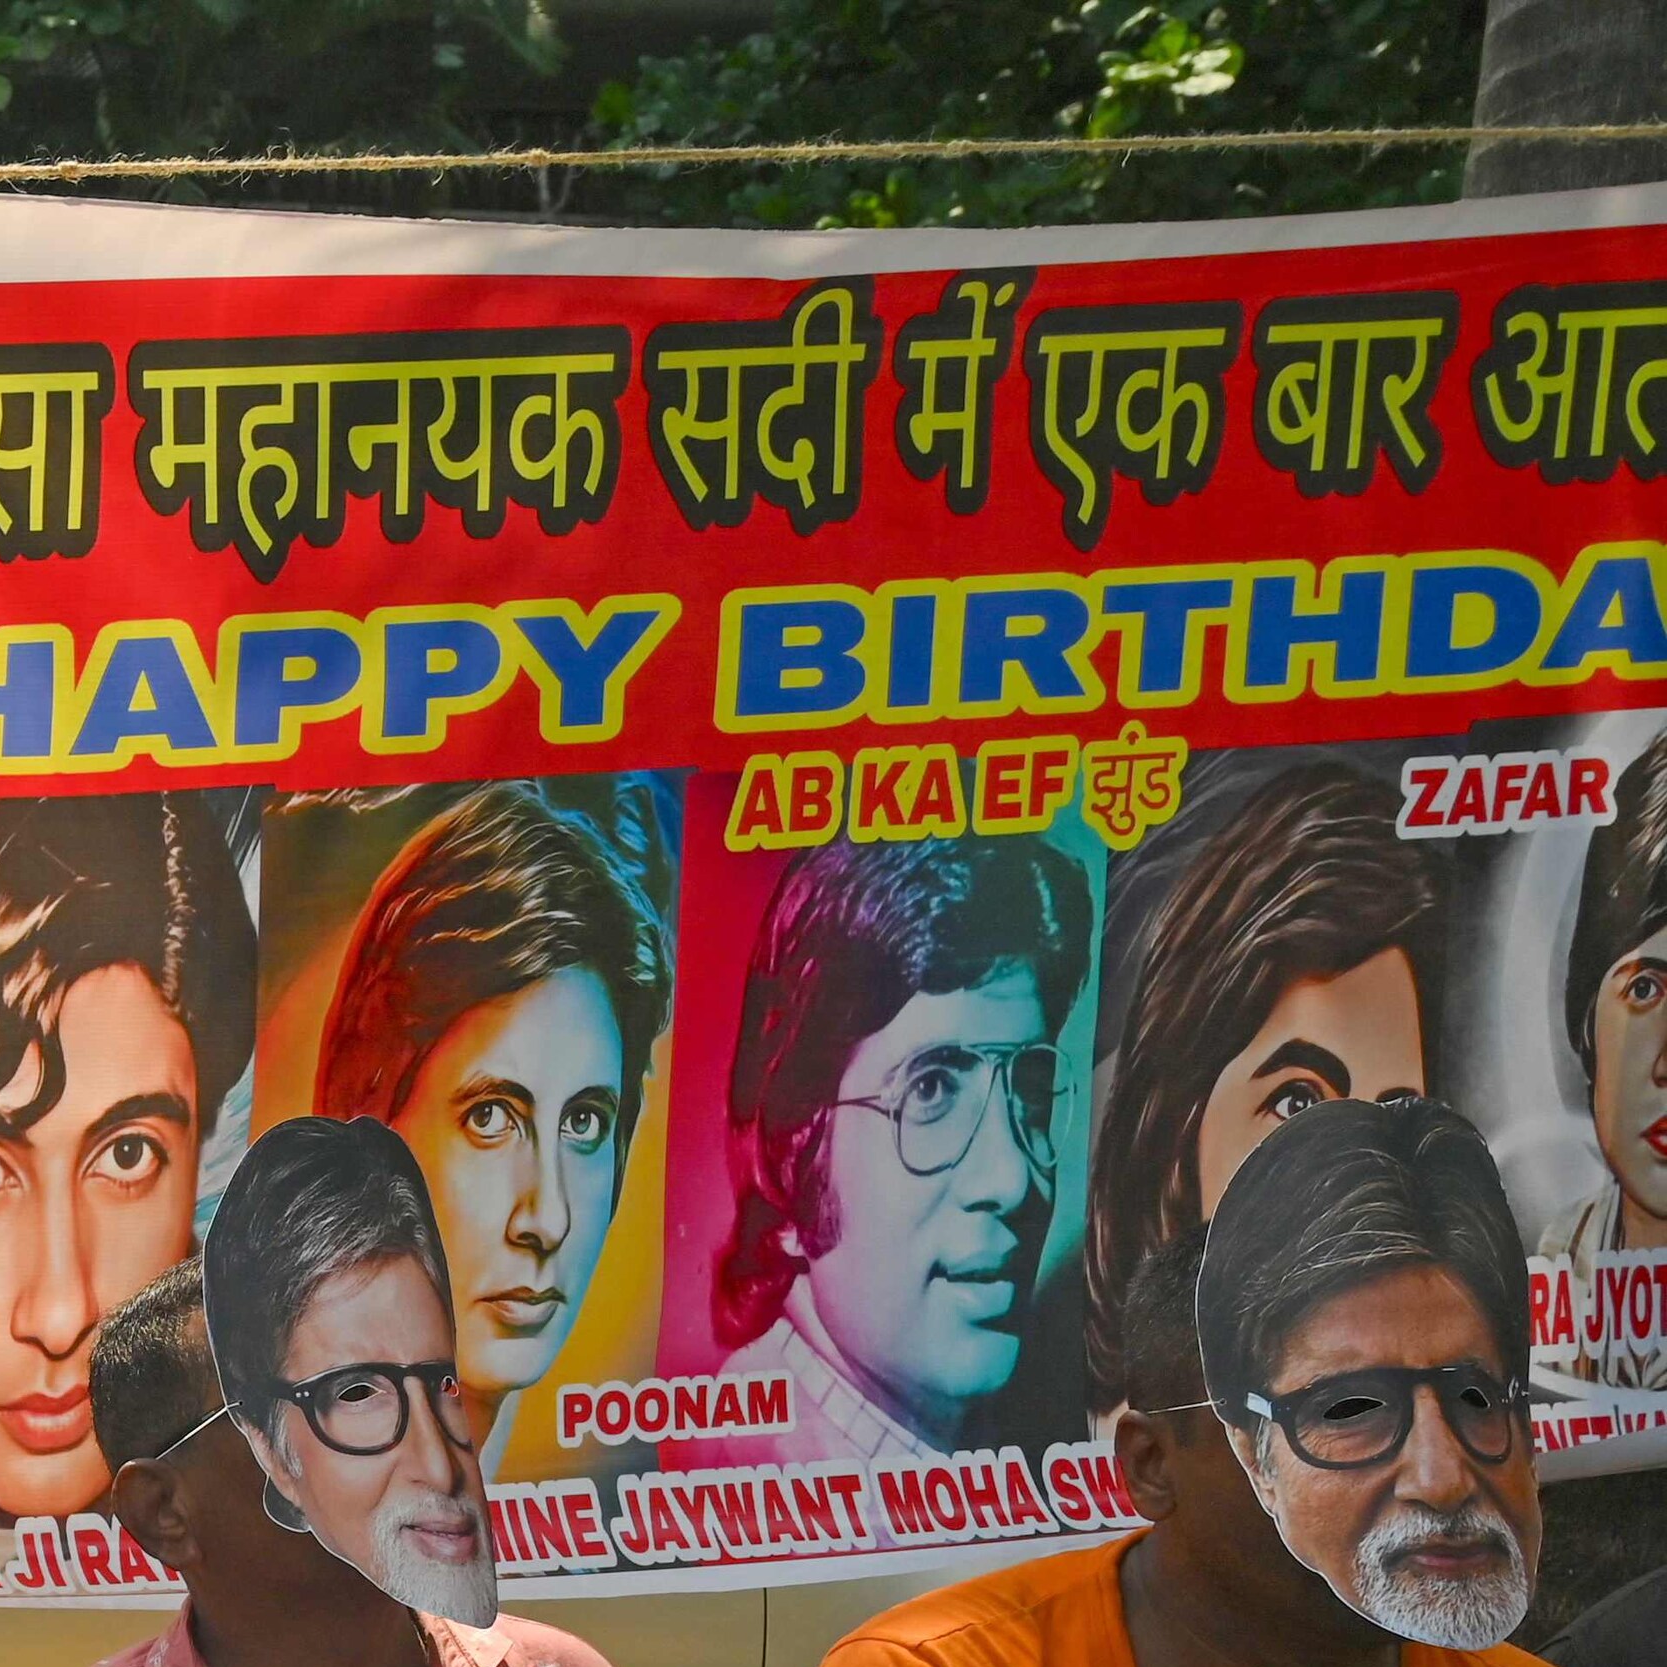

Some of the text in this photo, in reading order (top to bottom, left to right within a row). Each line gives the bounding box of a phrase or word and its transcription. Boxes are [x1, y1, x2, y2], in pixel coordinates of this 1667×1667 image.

[142, 352, 615, 557] महानयक
[658, 288, 866, 509] सदी
[909, 281, 1015, 489] में
[1038, 327, 1226, 525] एक
[1266, 317, 1442, 472] बार
[735, 766, 833, 836] AB
[858, 758, 956, 828] KA
[982, 750, 1070, 820] EF
[1408, 758, 1609, 828] ZAFAR
[1529, 1269, 1576, 1346] RA
[563, 1379, 789, 1439] POONAM
[620, 1475, 867, 1553] JAYWANT
[877, 1461, 1049, 1534] MOHA
[15, 1532, 68, 1588] JI
